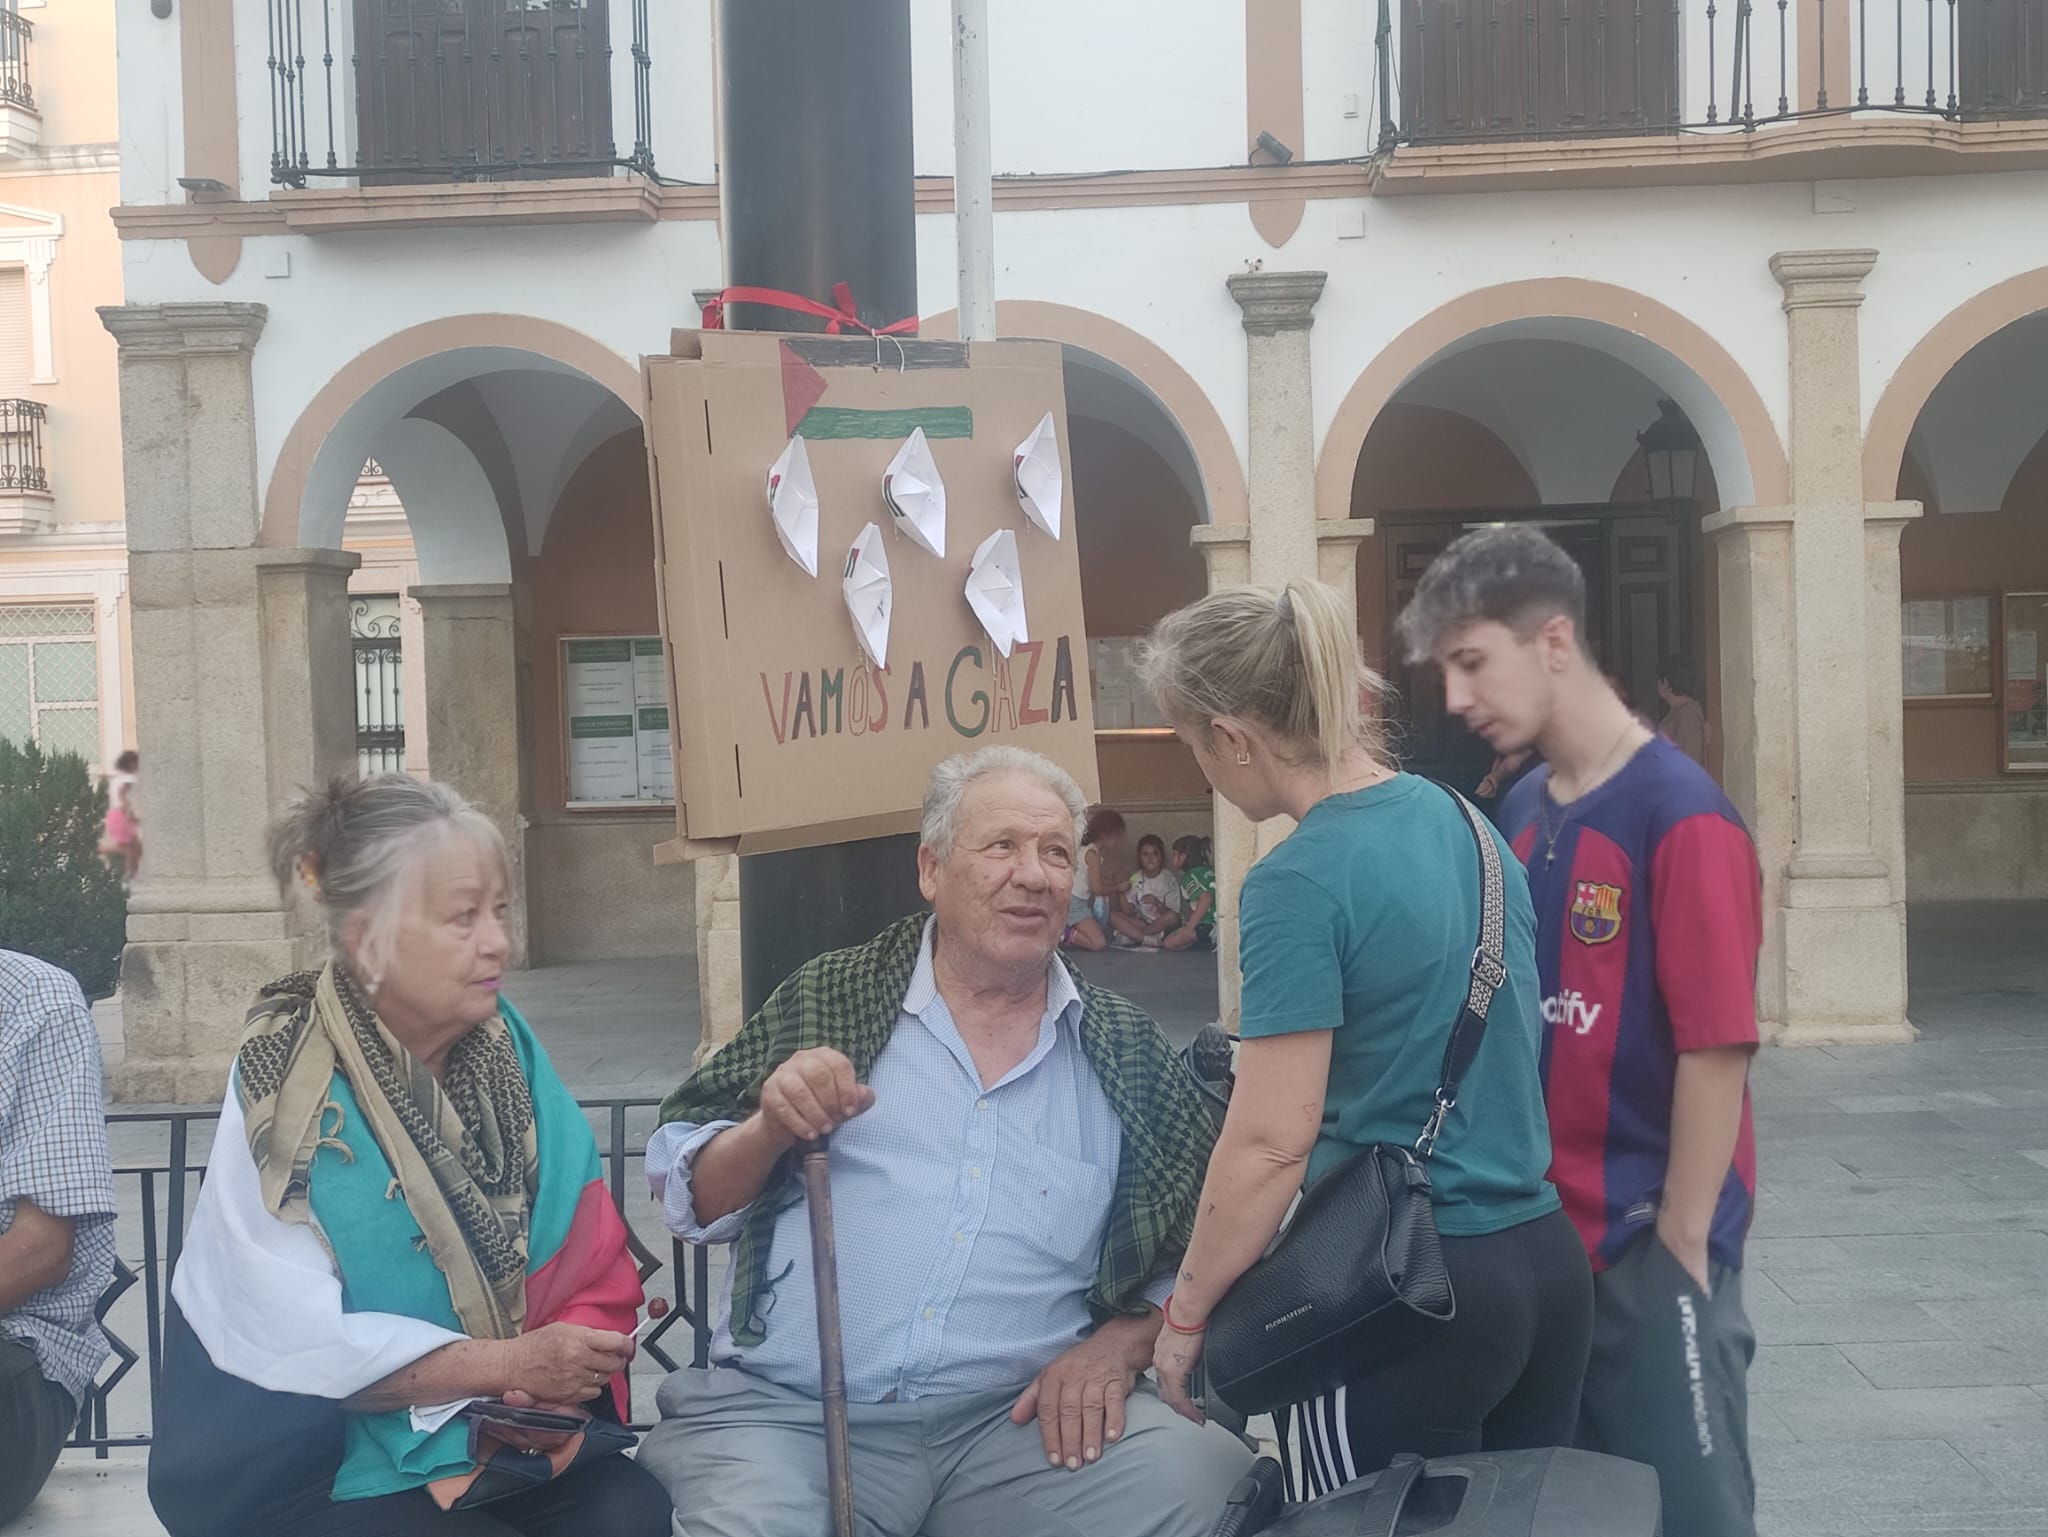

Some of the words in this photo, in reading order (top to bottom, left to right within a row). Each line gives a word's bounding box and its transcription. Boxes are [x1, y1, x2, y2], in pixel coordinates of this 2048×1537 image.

[759, 663, 892, 746] VAMOS
[904, 660, 930, 730] A
[945, 635, 1078, 738] GAZA
[1540, 987, 1602, 1035] otify
